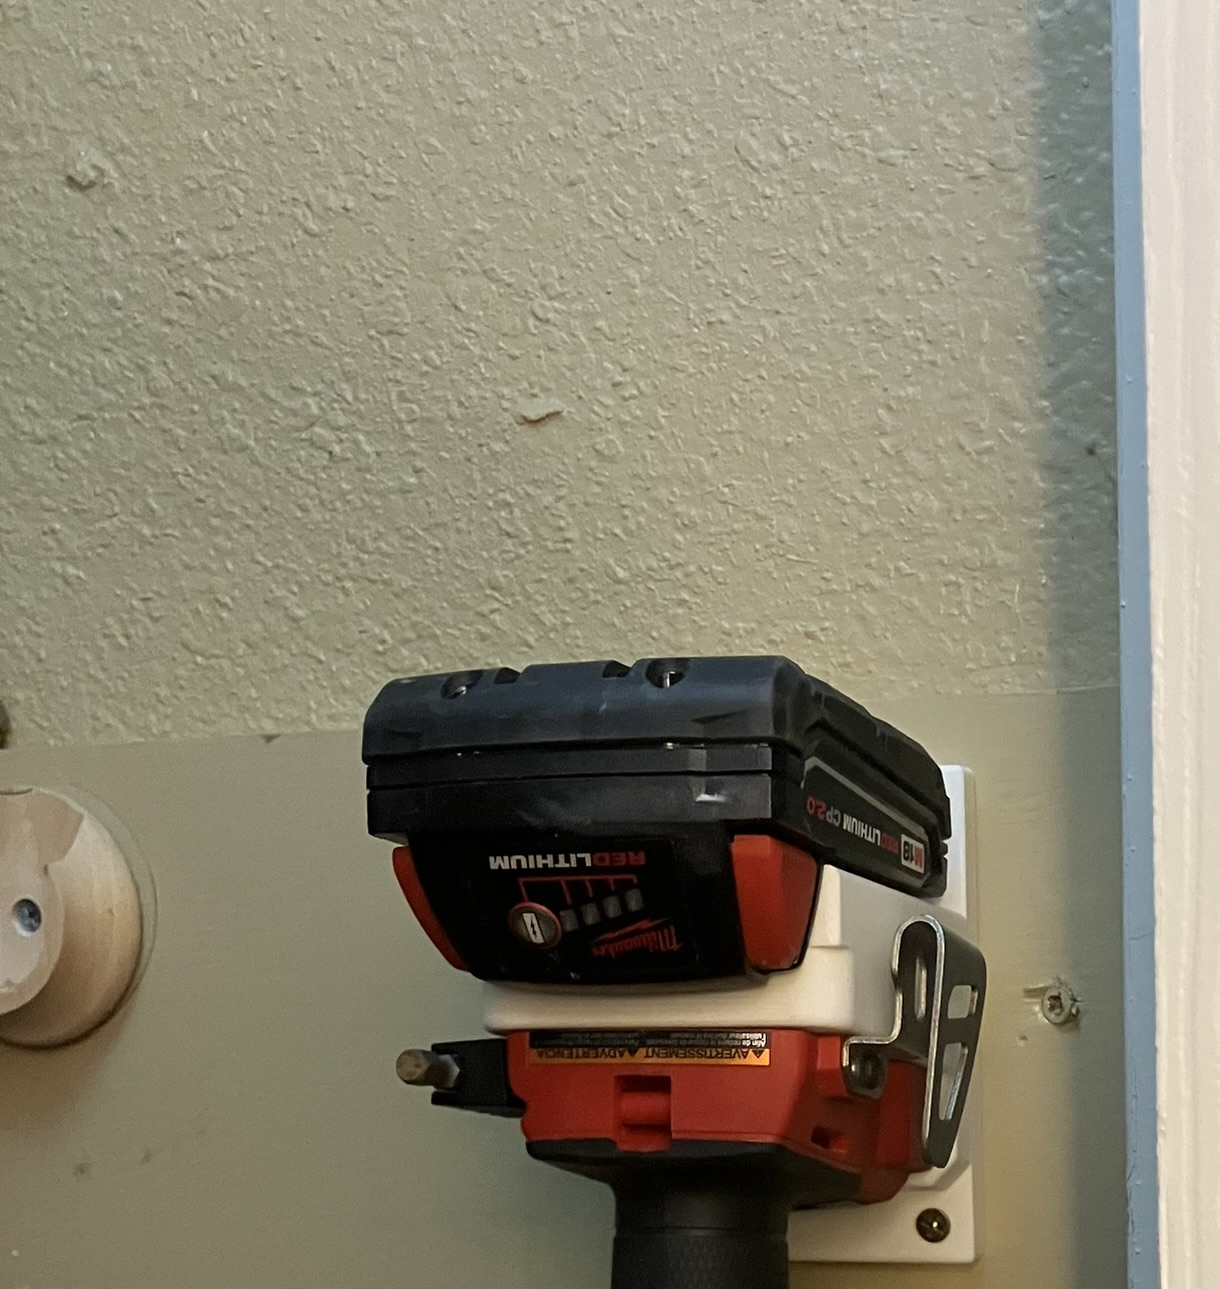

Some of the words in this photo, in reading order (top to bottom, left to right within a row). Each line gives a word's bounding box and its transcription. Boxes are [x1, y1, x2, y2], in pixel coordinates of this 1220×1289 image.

[489, 851, 647, 870] REDLITHIUM
[903, 840, 923, 869] M18
[536, 1047, 625, 1059] ADVERTENCIA
[643, 1047, 750, 1060] AVERTISSEMENT
